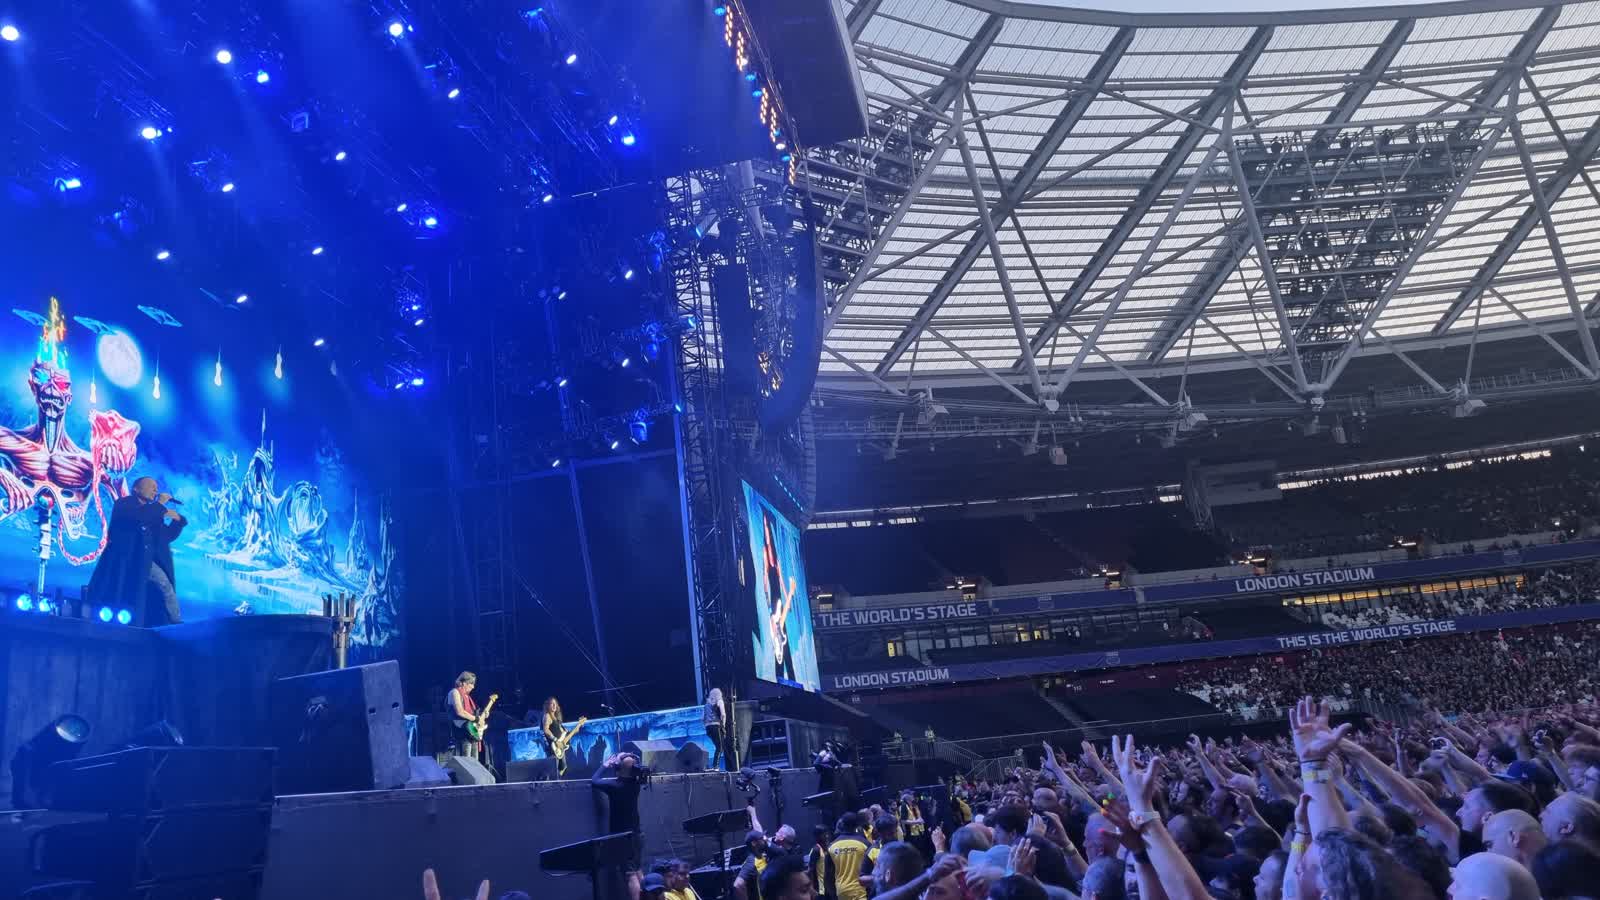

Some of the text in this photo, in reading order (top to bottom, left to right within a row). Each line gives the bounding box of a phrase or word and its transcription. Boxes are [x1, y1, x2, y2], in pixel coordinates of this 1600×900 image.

[1235, 567, 1375, 592] LONDON STADIUM
[819, 613, 850, 627] THE
[853, 608, 924, 625] WORLD'S
[927, 603, 977, 619] STAGE
[1277, 620, 1457, 649] THIS IS THE WORLD'S STAGE
[834, 667, 949, 689] LONDON STADIUM
